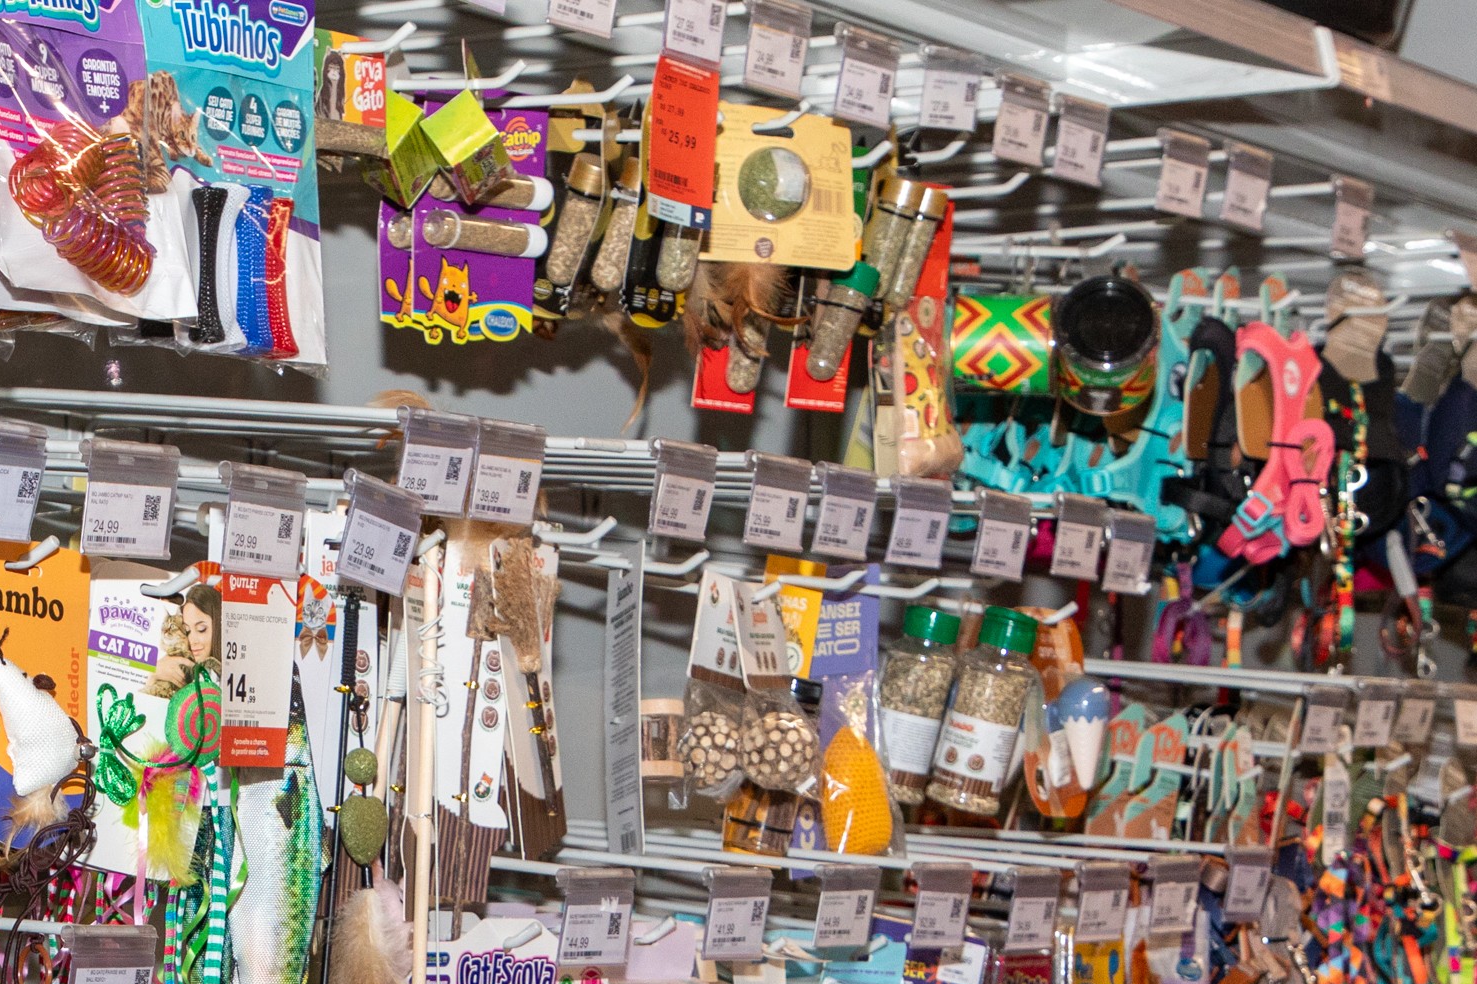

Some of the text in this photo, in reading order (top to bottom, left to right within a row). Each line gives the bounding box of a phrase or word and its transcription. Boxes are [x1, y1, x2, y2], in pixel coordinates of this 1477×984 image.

[175, 2, 279, 66] Tubinhos
[39, 44, 48, 64] 9
[82, 58, 117, 73] GARANTIA
[354, 60, 384, 81] erva
[82, 70, 120, 87] DE MUITAS
[86, 83, 120, 101] EMOÇÕES
[353, 89, 384, 112] Gato
[249, 97, 257, 114] 4
[245, 113, 262, 127] SUPER
[242, 124, 265, 139] TUBINHOS
[668, 130, 697, 150] 25,99
[405, 477, 427, 491] 28,99
[479, 489, 500, 504] 39,99
[93, 519, 120, 534] 24,99
[234, 533, 258, 550] 29,99
[353, 541, 374, 560] 23,99
[230, 575, 260, 591] OUTLET
[99, 603, 151, 633] pawise
[266, 616, 288, 625] OCTOPUS
[835, 620, 861, 637] SER
[98, 635, 153, 663] CAT TOY
[227, 641, 237, 661] 29
[227, 673, 247, 704] 14
[568, 937, 589, 949] 44,99
